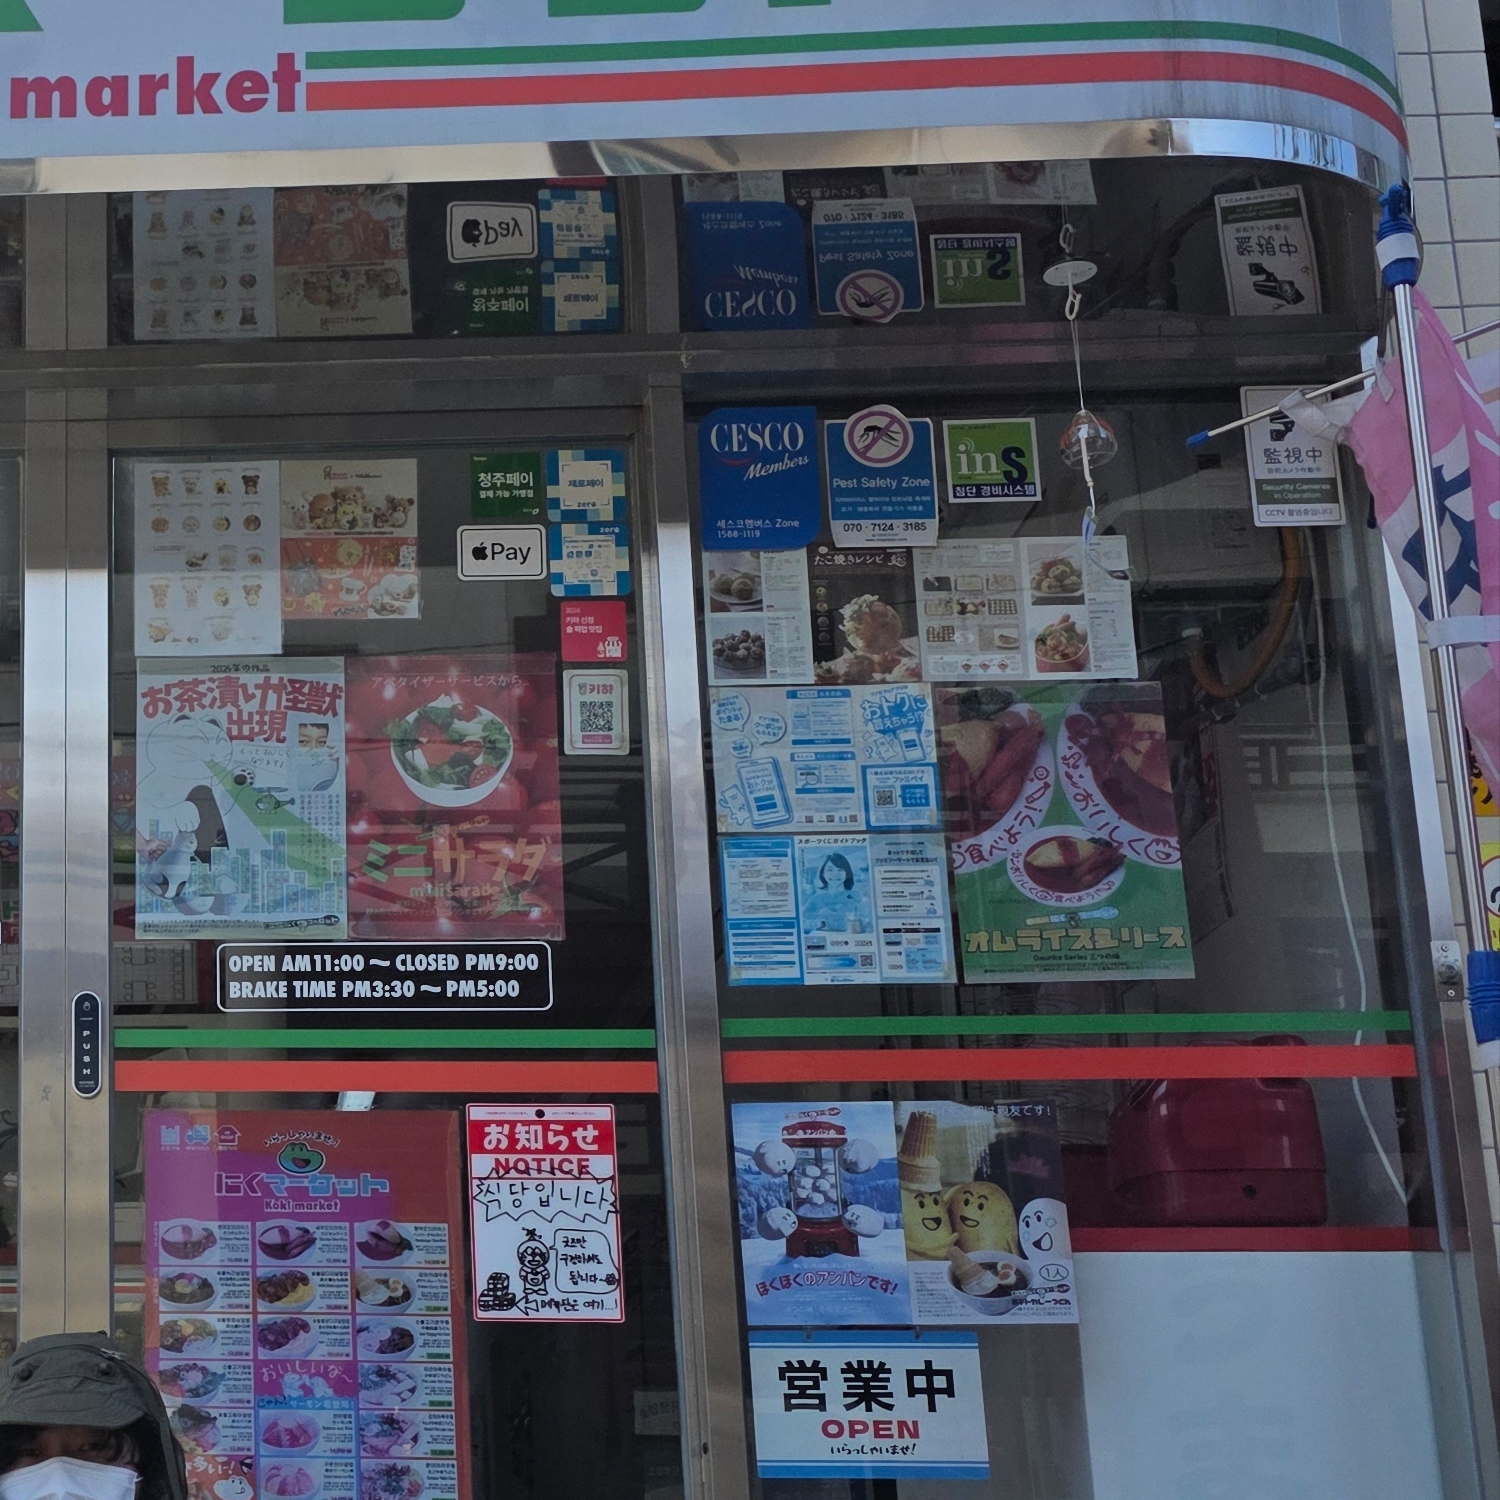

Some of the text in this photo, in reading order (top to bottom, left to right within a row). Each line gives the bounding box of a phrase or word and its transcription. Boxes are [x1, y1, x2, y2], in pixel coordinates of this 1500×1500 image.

[8, 52, 306, 119] market
[710, 421, 805, 453] CESCO
[1263, 446, 1323, 465] 監視中
[743, 453, 810, 482] Members
[477, 471, 534, 488] 청주페이
[833, 476, 931, 490] Pest Safety Zone
[955, 484, 1035, 497] 첨단 경비시스템
[1265, 509, 1285, 517] CCTV
[775, 518, 800, 529] Zone
[843, 522, 928, 533] 070 7124 3185
[717, 529, 761, 539] 1588-1119
[490, 542, 532, 566] Pay
[813, 554, 885, 566] たこ焼きレシピ
[588, 683, 614, 695] 키하
[226, 710, 288, 743] 出現
[361, 836, 555, 883] ミニサラダ
[228, 955, 276, 972] OPEN
[281, 954, 365, 972] AM11:00
[395, 954, 460, 972] CLOSED
[465, 953, 539, 971] PM9:00
[229, 981, 288, 998] BRAKE
[293, 980, 337, 997] TIME
[342, 980, 416, 997] PM3:30
[446, 980, 520, 997] PM5:00
[82, 1030, 91, 1075] PUSH
[483, 1123, 600, 1151] お知らせ
[493, 1157, 591, 1175] NOTICE
[214, 1171, 391, 1198] にくマーケット
[483, 1180, 610, 1211] 식당입니다
[264, 1199, 341, 1213] Koki market
[755, 1270, 899, 1297] ほくほくのアンパンです!
[777, 1358, 957, 1413] 営業中
[821, 1418, 921, 1440] OPEN
[830, 1443, 916, 1456] いらっしゃいませ!
